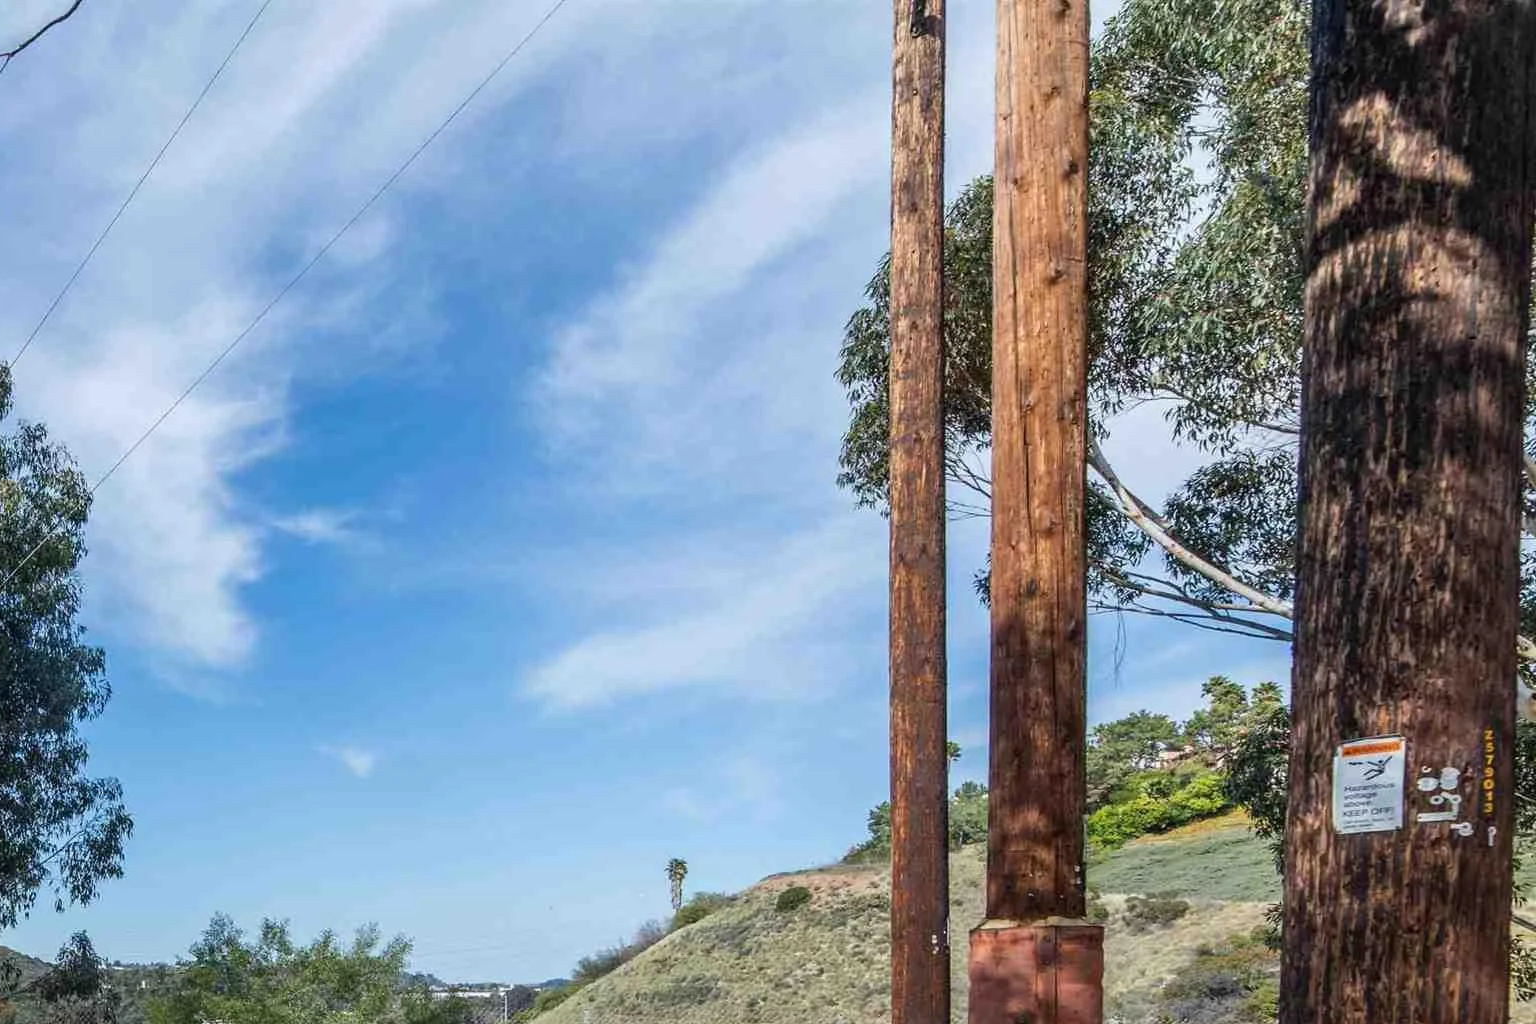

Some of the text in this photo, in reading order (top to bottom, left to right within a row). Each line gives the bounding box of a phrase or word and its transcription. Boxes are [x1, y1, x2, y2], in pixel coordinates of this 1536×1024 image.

[1344, 783, 1395, 792] Hazardous
[1344, 792, 1377, 801] voltage
[1343, 808, 1368, 817] KEEP
